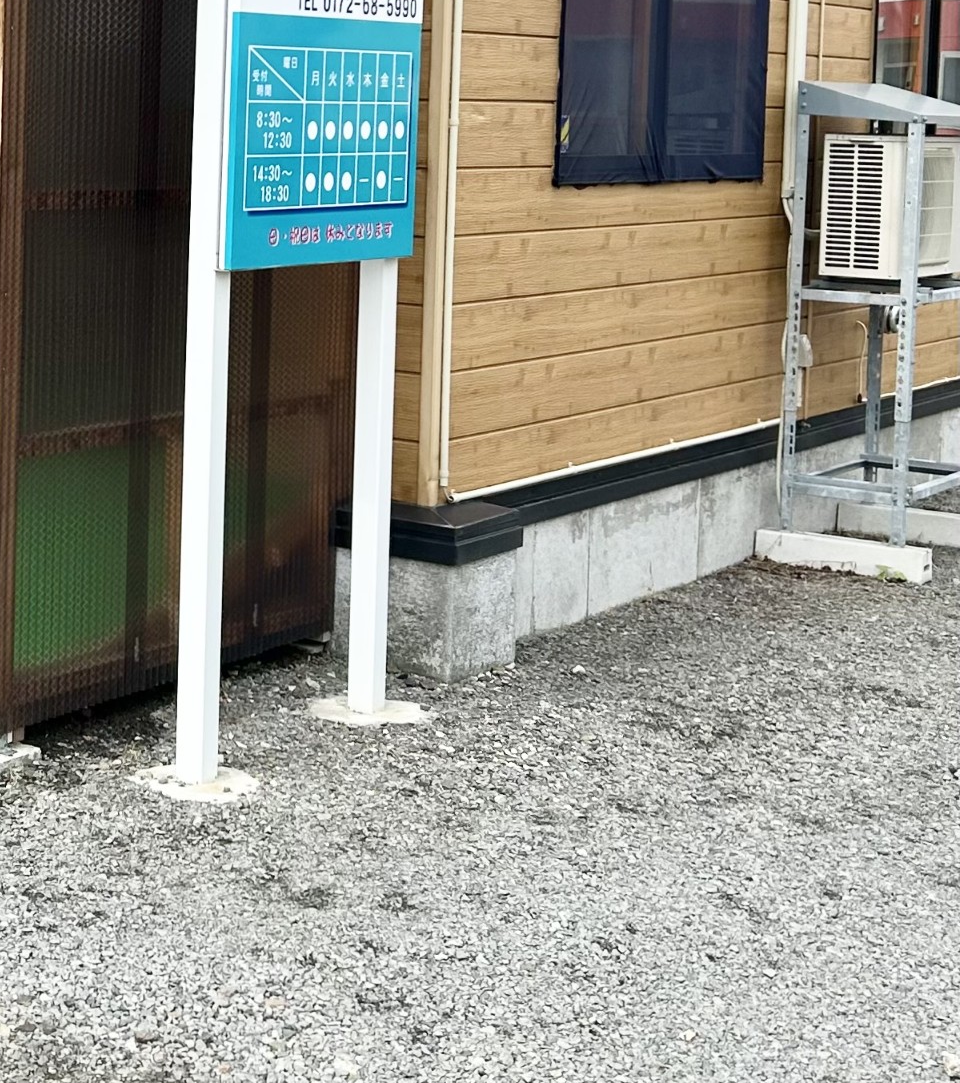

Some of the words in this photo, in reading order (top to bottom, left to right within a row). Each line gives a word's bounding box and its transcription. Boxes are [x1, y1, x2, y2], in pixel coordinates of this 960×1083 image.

[283, 56, 298, 69] 曜日
[251, 69, 268, 82] 受付
[311, 70, 320, 87] 月
[328, 71, 338, 87] 火
[345, 71, 355, 88] 水
[362, 72, 373, 88] 木
[380, 72, 390, 88] 金
[396, 73, 406, 89] 土
[256, 84, 273, 97] 時間
[263, 131, 292, 149] 12:30
[260, 184, 290, 203] 18:30
